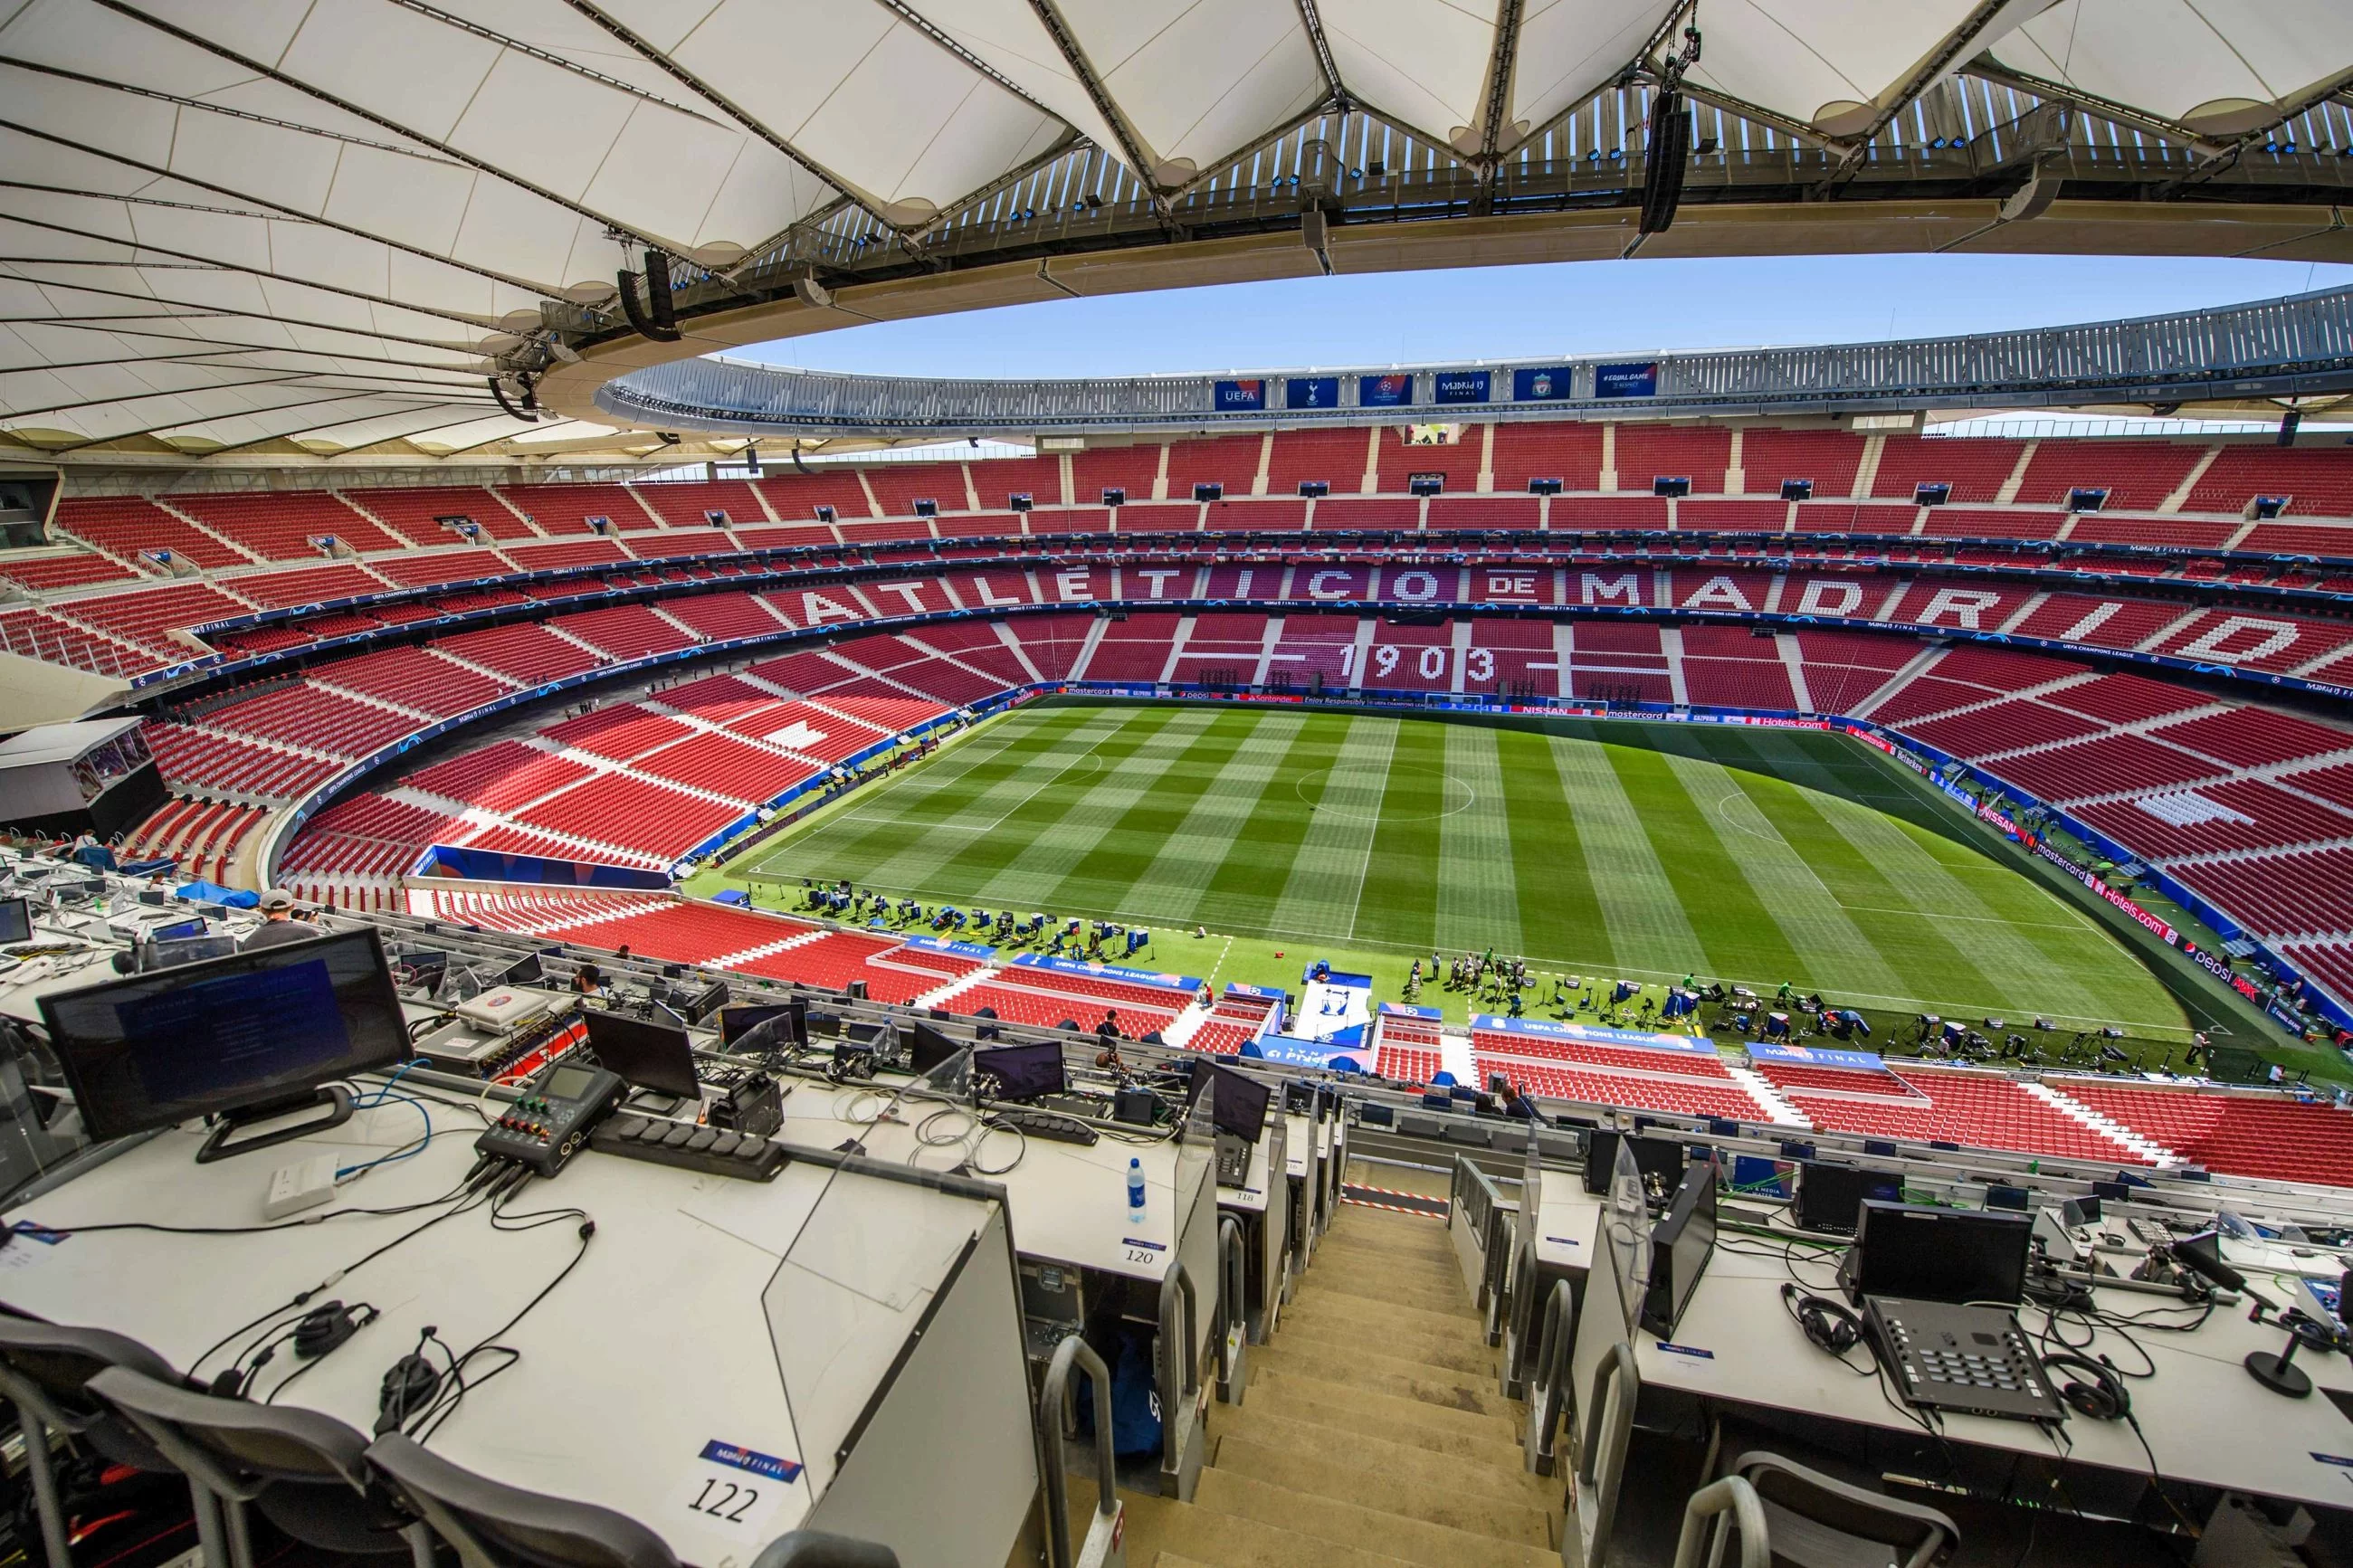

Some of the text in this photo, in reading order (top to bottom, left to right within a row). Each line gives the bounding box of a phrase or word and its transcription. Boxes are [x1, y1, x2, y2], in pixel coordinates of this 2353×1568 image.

[1225, 392, 1255, 401] UEFA
[802, 565, 2301, 665] ATLÉTICO DE MADRID
[2078, 645, 2110, 655] CHAMPIONS
[2111, 649, 2134, 659] LEAGUE
[1339, 644, 1494, 681] 1903
[1015, 690, 1034, 705] NISSAN
[1069, 687, 1110, 695] mastercard
[1304, 697, 1366, 706] Enjoy Responsibly
[1523, 706, 1567, 715] NISSAN
[1608, 710, 1662, 719] mastercard
[1763, 717, 1822, 729] Hotels.com
[1859, 730, 1886, 750] Santander
[1897, 749, 1923, 774] Heineken
[1983, 806, 2017, 833] NISSAN
[2037, 844, 2086, 881] mastercard
[2105, 889, 2163, 934] Hotels.com
[952, 943, 983, 955] FINAL
[1055, 960, 1157, 982] UEFA CHAMPIONS LEAGUE
[2196, 951, 2260, 1003] pepsi MAX
[1524, 1021, 1657, 1044] UEFA CHAMPIONS LEAGUE
[1819, 1052, 1867, 1064] FINAL
[1126, 1249, 1154, 1265] 120
[753, 1458, 784, 1475] FINAL
[688, 1478, 758, 1524] 122
